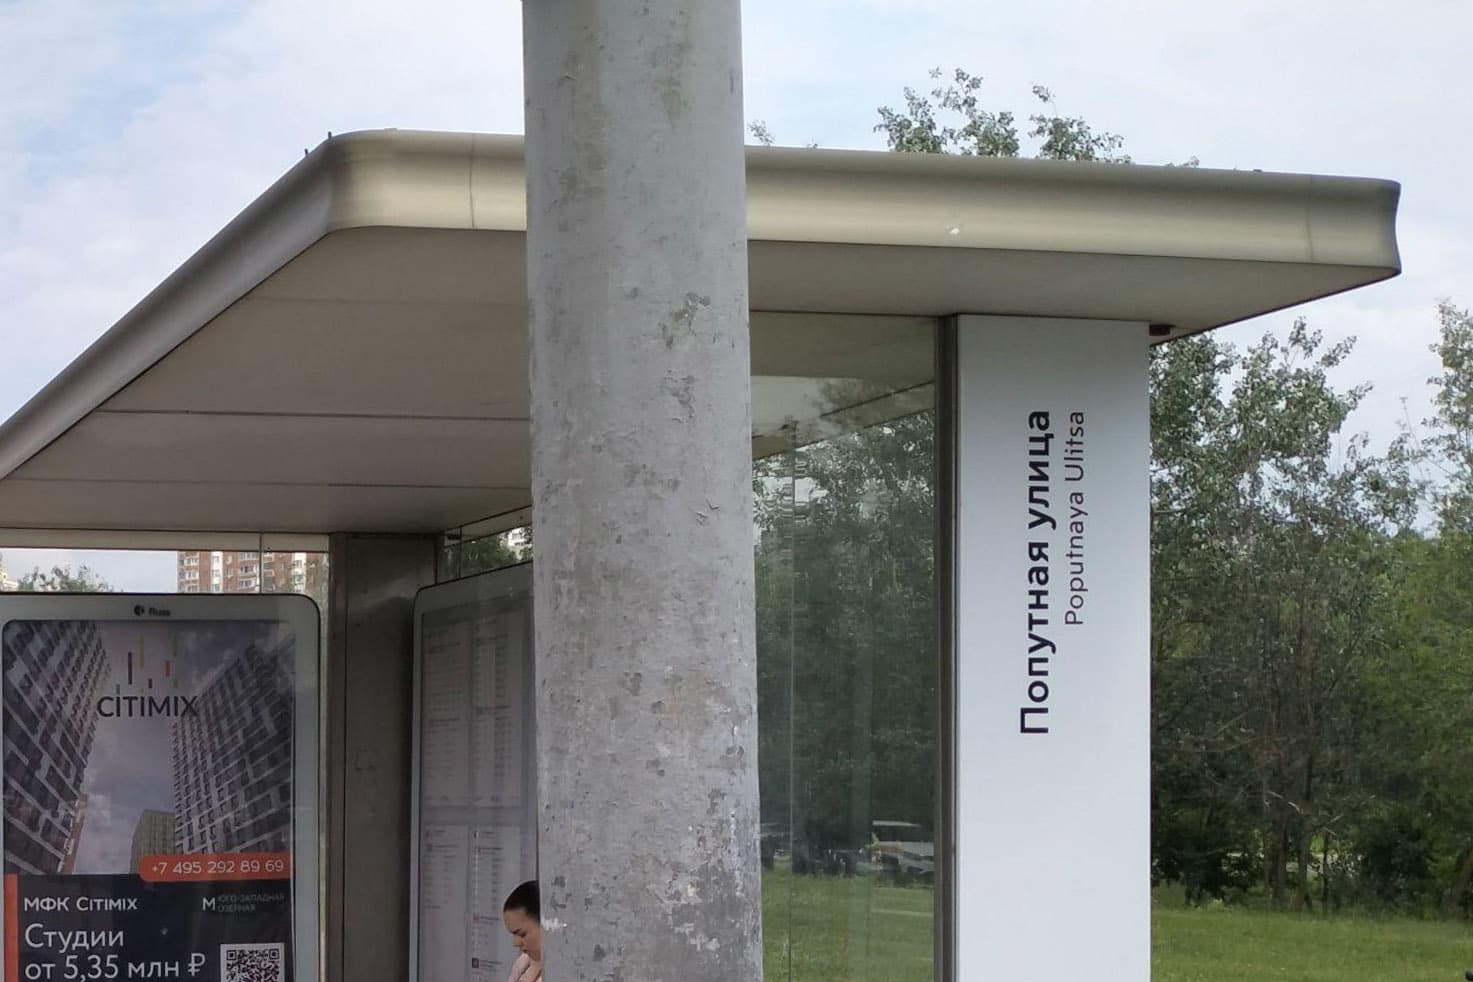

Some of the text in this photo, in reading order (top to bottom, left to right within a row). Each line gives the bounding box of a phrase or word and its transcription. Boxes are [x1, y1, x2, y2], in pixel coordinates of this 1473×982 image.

[1064, 410, 1089, 626] Poputnaya Ulitsa
[1019, 410, 1057, 735] Попутная улица
[151, 859, 284, 875] +7 495 292 89 69
[23, 896, 70, 912] МФК
[24, 922, 124, 954] Студии
[25, 962, 56, 980] от
[63, 954, 119, 982] 5,35
[128, 961, 180, 979] млн
